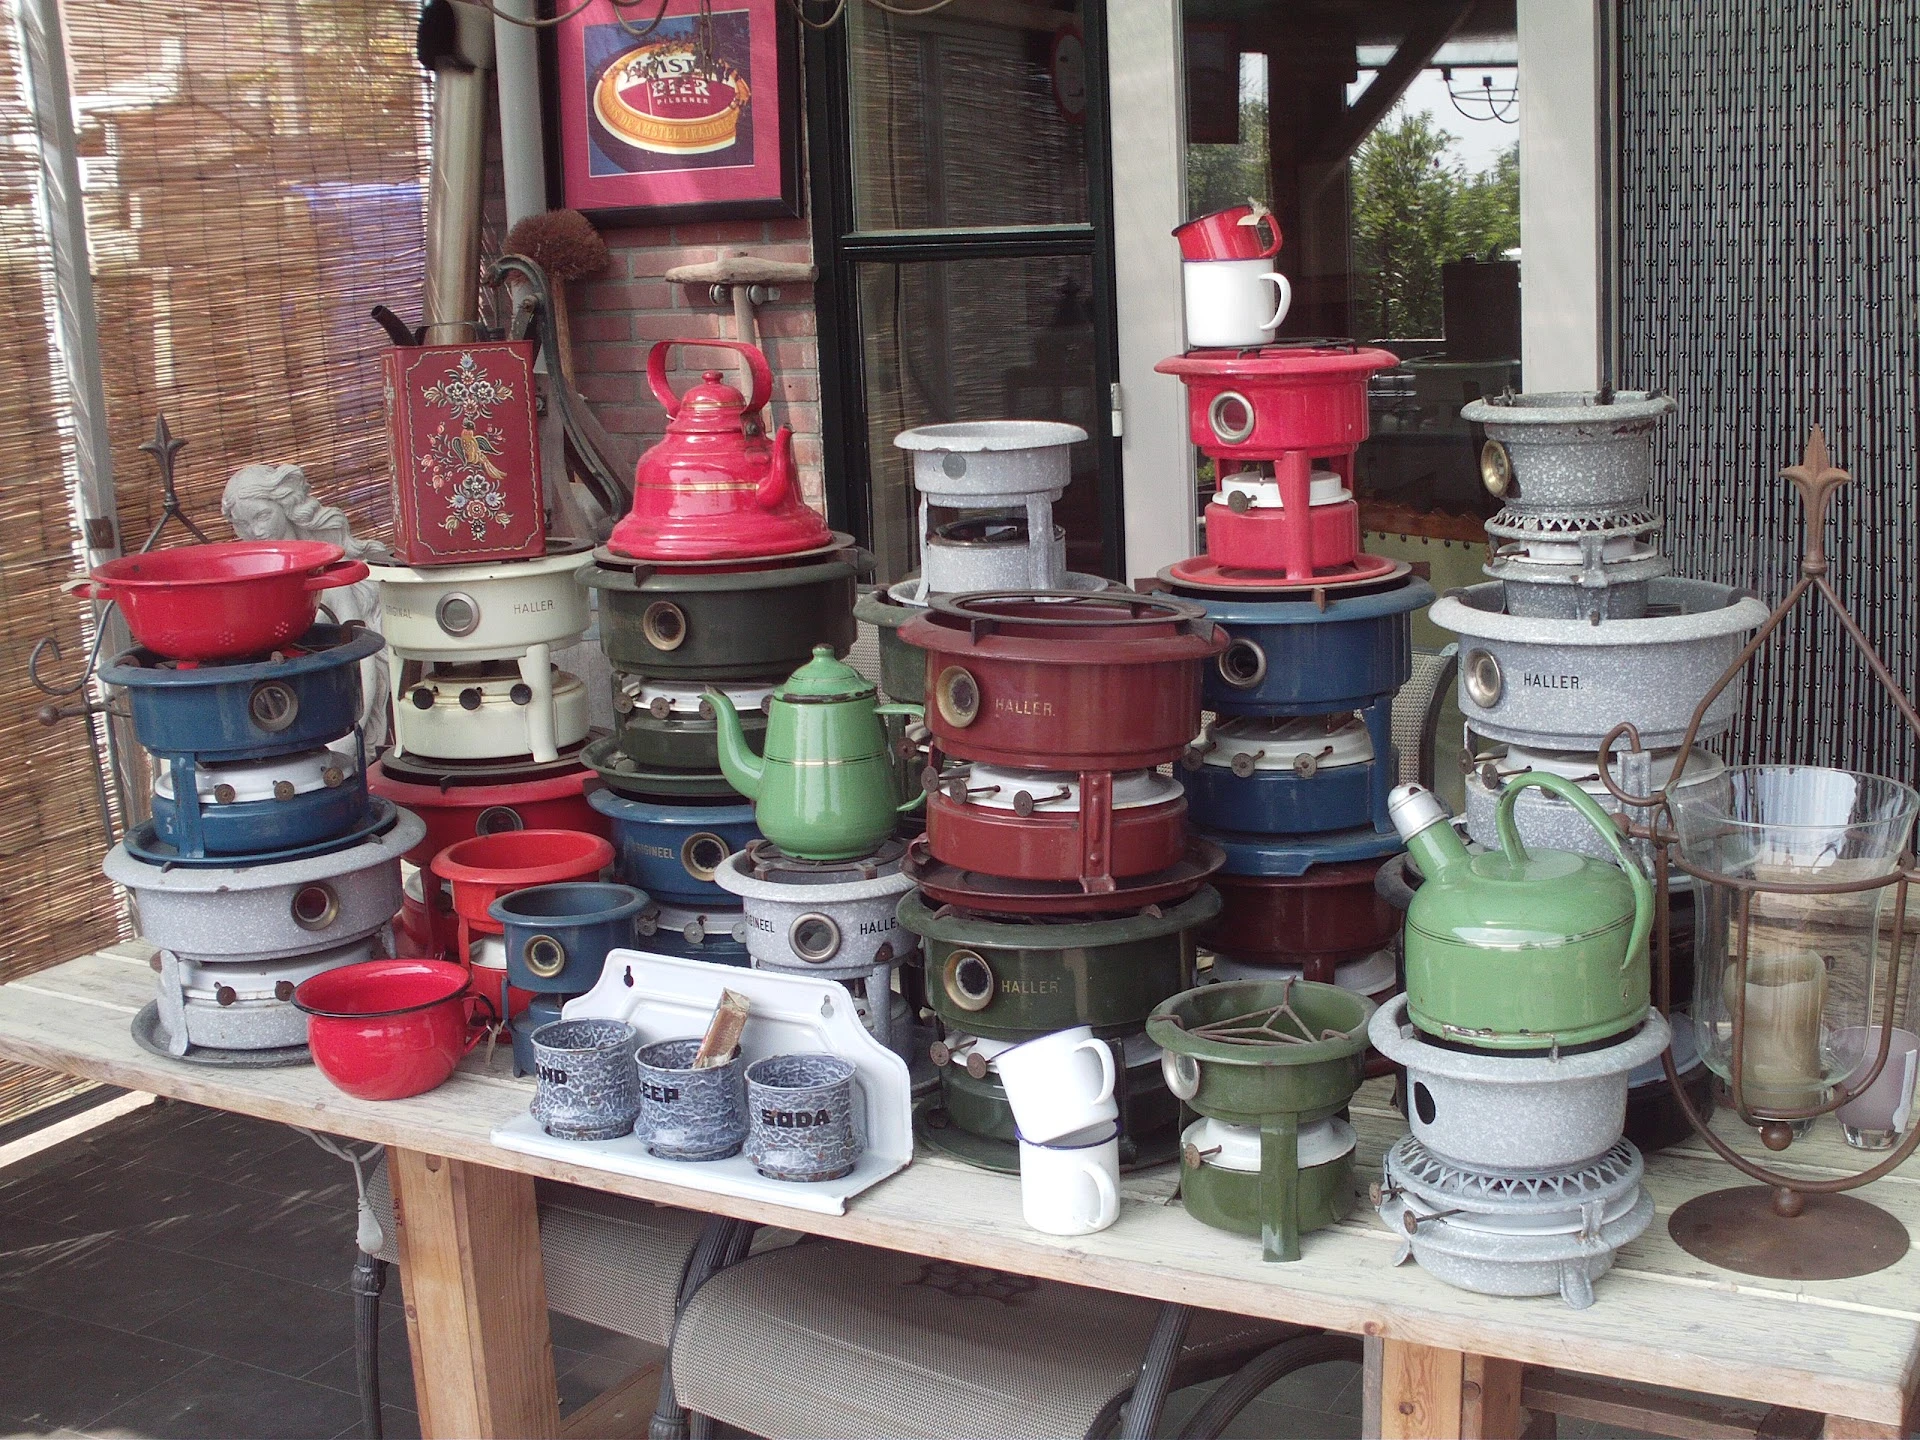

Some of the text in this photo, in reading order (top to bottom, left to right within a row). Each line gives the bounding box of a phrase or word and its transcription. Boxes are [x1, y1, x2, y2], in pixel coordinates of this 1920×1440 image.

[656, 96, 710, 106] PILSENER
[634, 121, 680, 140] AMSTEL
[859, 916, 901, 936] HALLE
[535, 1062, 569, 1085] AND
[640, 1081, 680, 1104] EEP
[761, 1108, 832, 1129] SODA
